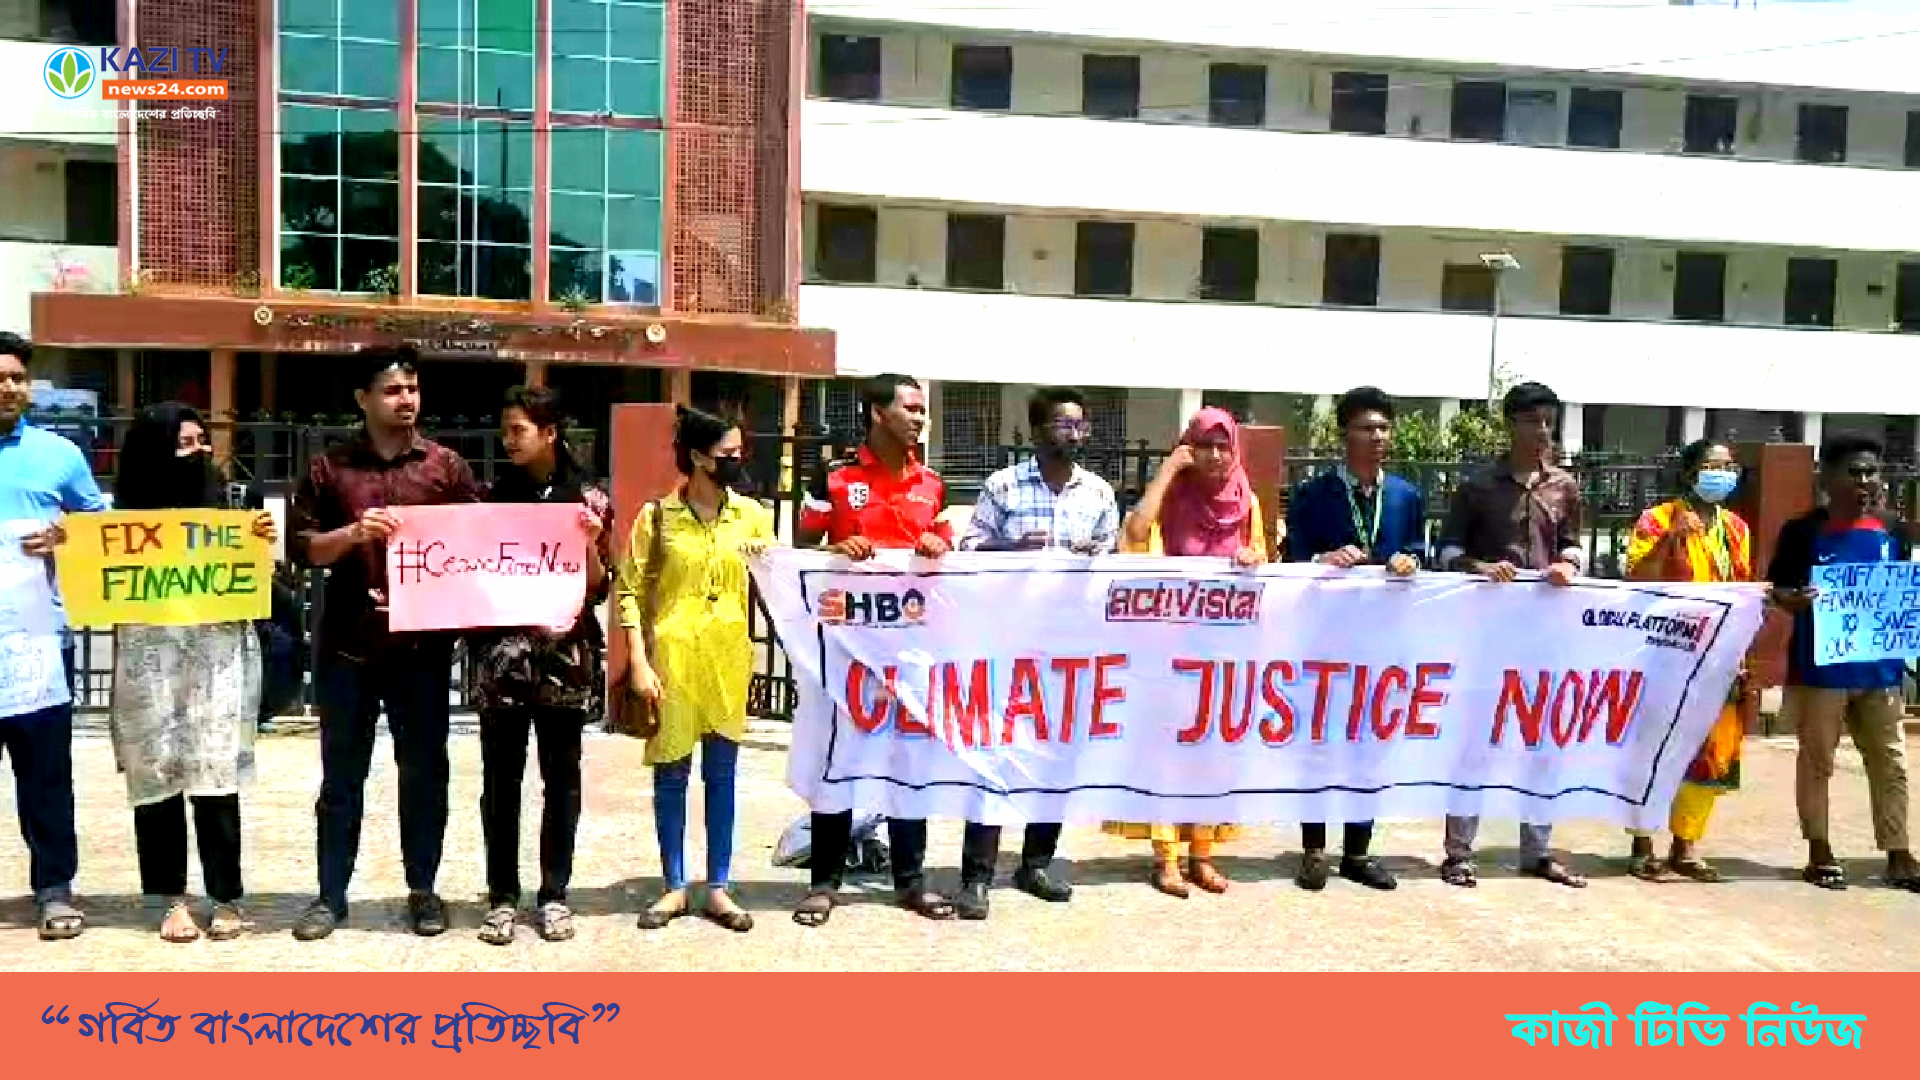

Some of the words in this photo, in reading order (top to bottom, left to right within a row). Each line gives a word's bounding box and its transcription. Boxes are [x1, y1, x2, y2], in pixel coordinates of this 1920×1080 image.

[100, 522, 163, 556] FIX
[180, 522, 244, 549] THE
[102, 562, 257, 602] FINANCE
[846, 653, 1127, 750] CLIMATE
[1172, 660, 1452, 745] JUSTICE
[1490, 668, 1644, 748] NOW
